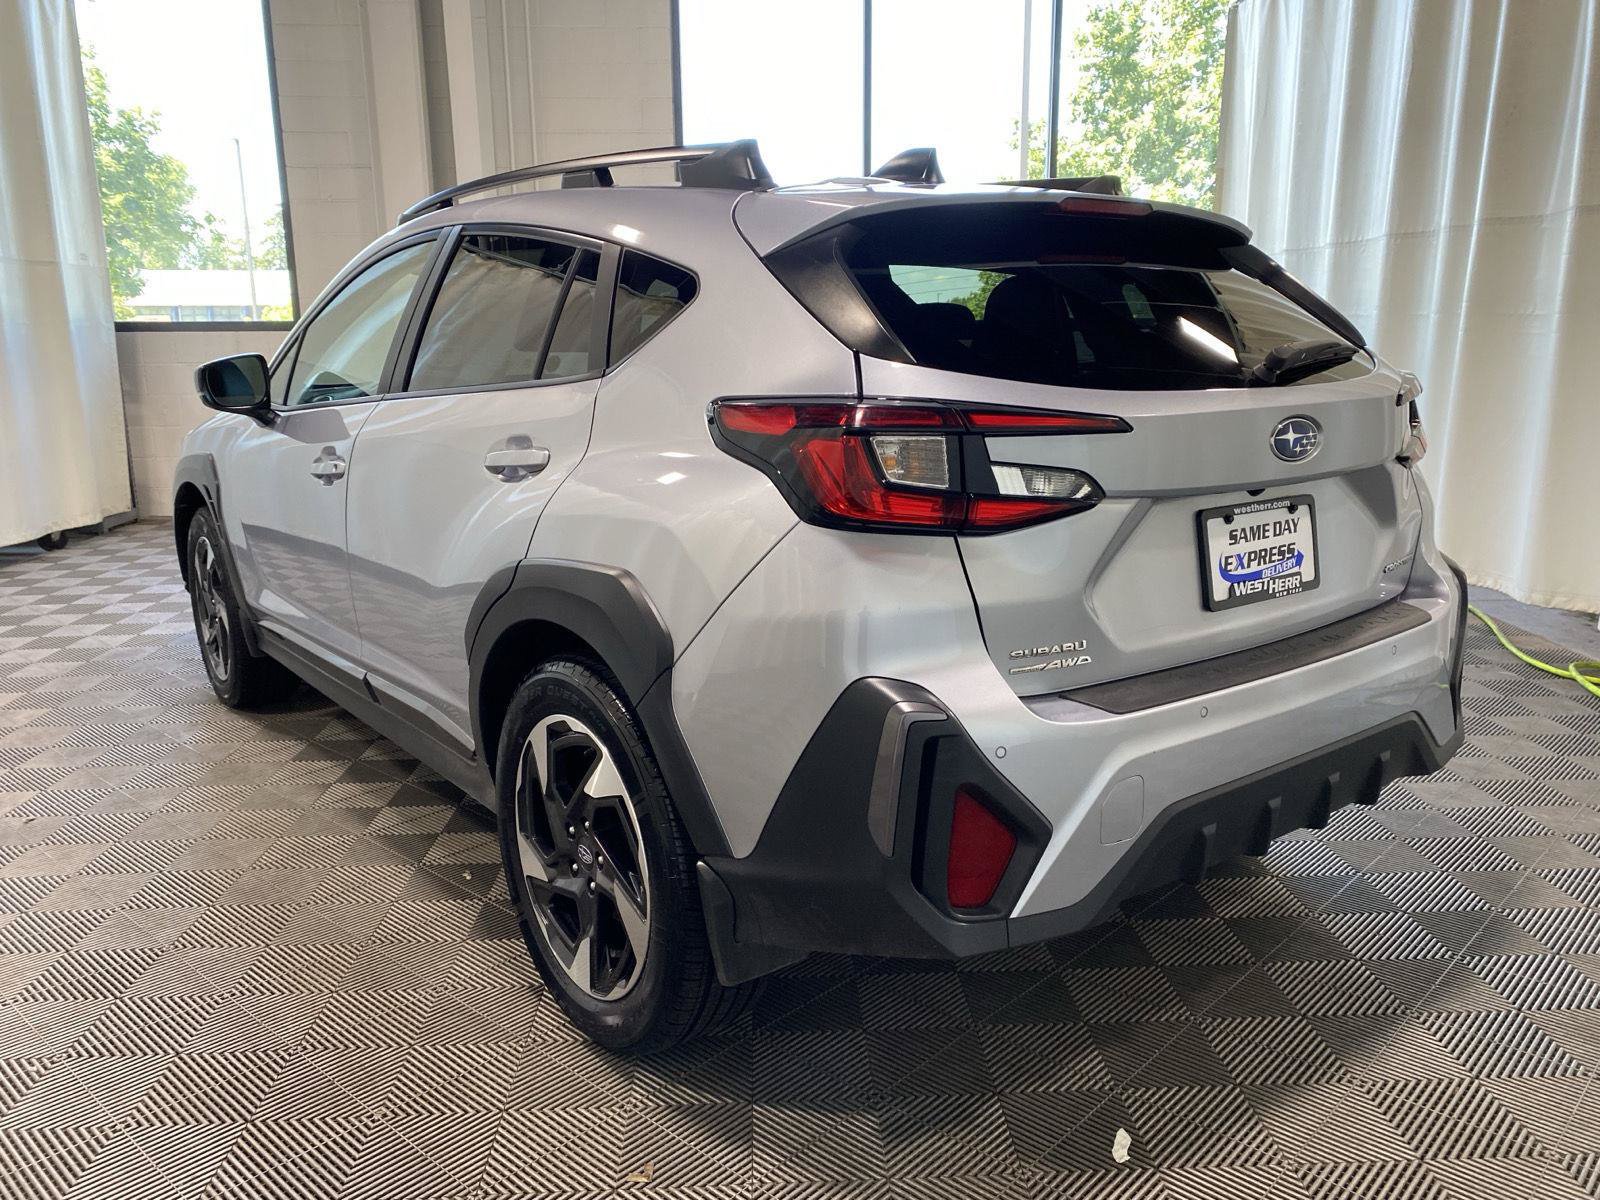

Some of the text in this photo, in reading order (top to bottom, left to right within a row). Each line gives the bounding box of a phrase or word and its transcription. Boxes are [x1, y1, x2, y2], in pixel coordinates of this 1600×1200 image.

[1233, 500, 1290, 514] westherr.com
[1229, 517, 1300, 546] SAME DAY
[1224, 542, 1296, 572] EXPRESS
[1262, 557, 1298, 578] DELIVERY
[1008, 640, 1086, 658] SUBARU
[1042, 656, 1092, 671] AWD
